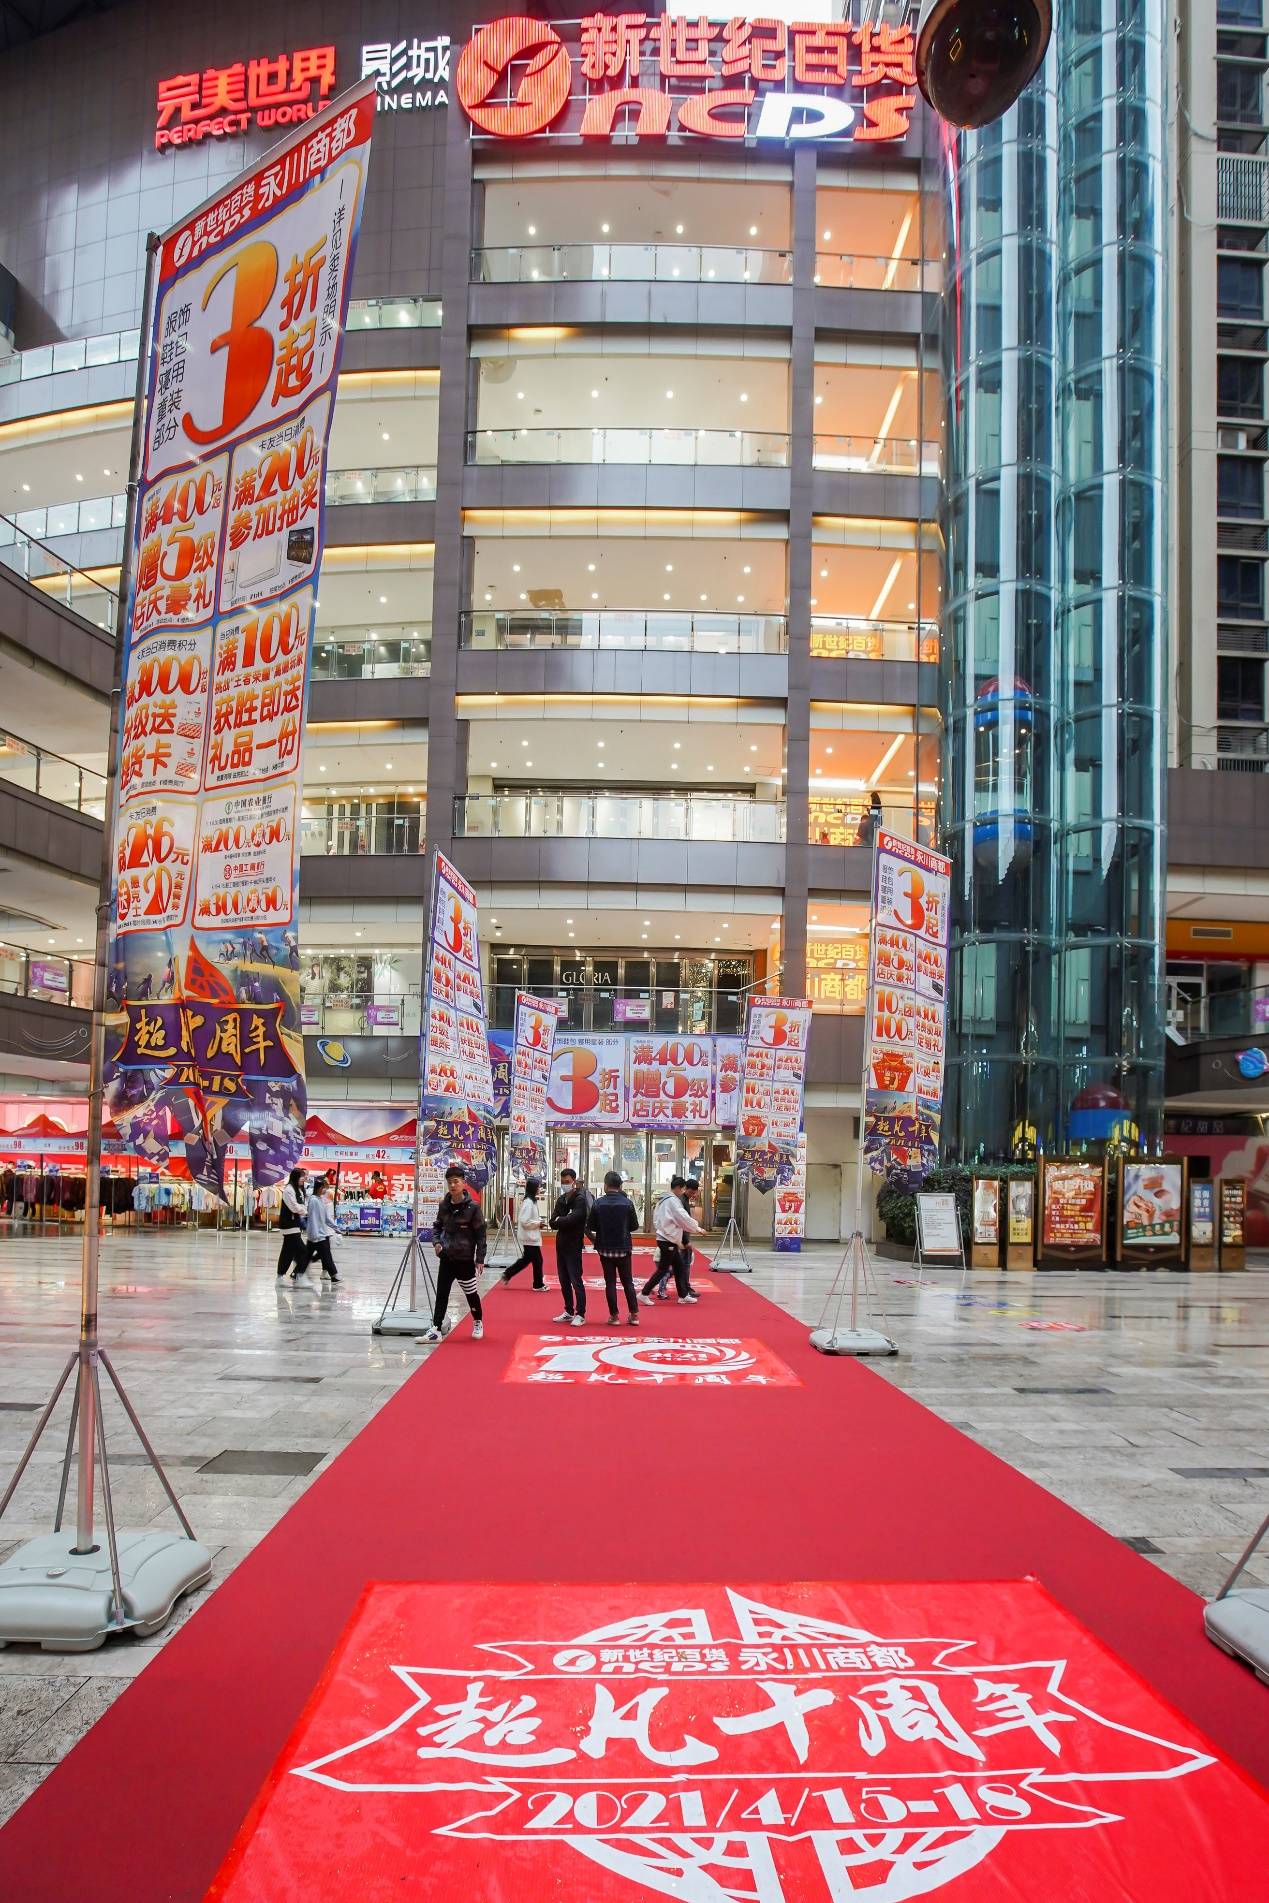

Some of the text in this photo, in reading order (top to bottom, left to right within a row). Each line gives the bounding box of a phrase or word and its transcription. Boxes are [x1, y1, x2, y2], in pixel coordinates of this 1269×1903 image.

[361, 36, 450, 91] 影城
[580, 12, 917, 87] 新世纪百货
[157, 45, 336, 128] 完美世界
[376, 88, 449, 111] INEMA
[155, 113, 252, 150] PERFECT
[257, 107, 358, 210] 永川商都
[194, 181, 255, 242] 新世纪百货
[182, 240, 279, 445] 3
[271, 235, 328, 408] 折起
[229, 470, 319, 551] 参加抽奖
[132, 574, 213, 632] 店庆豪礼
[212, 672, 301, 736] 获胜即送
[209, 716, 298, 775] 礼品一份
[444, 891, 462, 953] 3
[893, 866, 925, 931] 3
[525, 1011, 543, 1048] 3
[760, 1009, 789, 1047] 3
[546, 1047, 599, 1115] 3
[632, 1100, 708, 1119] 店庆豪礼
[599, 1648, 730, 1663] 新世纪百货
[738, 1645, 916, 1672] 永川商都
[416, 1677, 1078, 1769] 超凡十周年
[522, 1781, 1033, 1831] 2021/4/15-18
